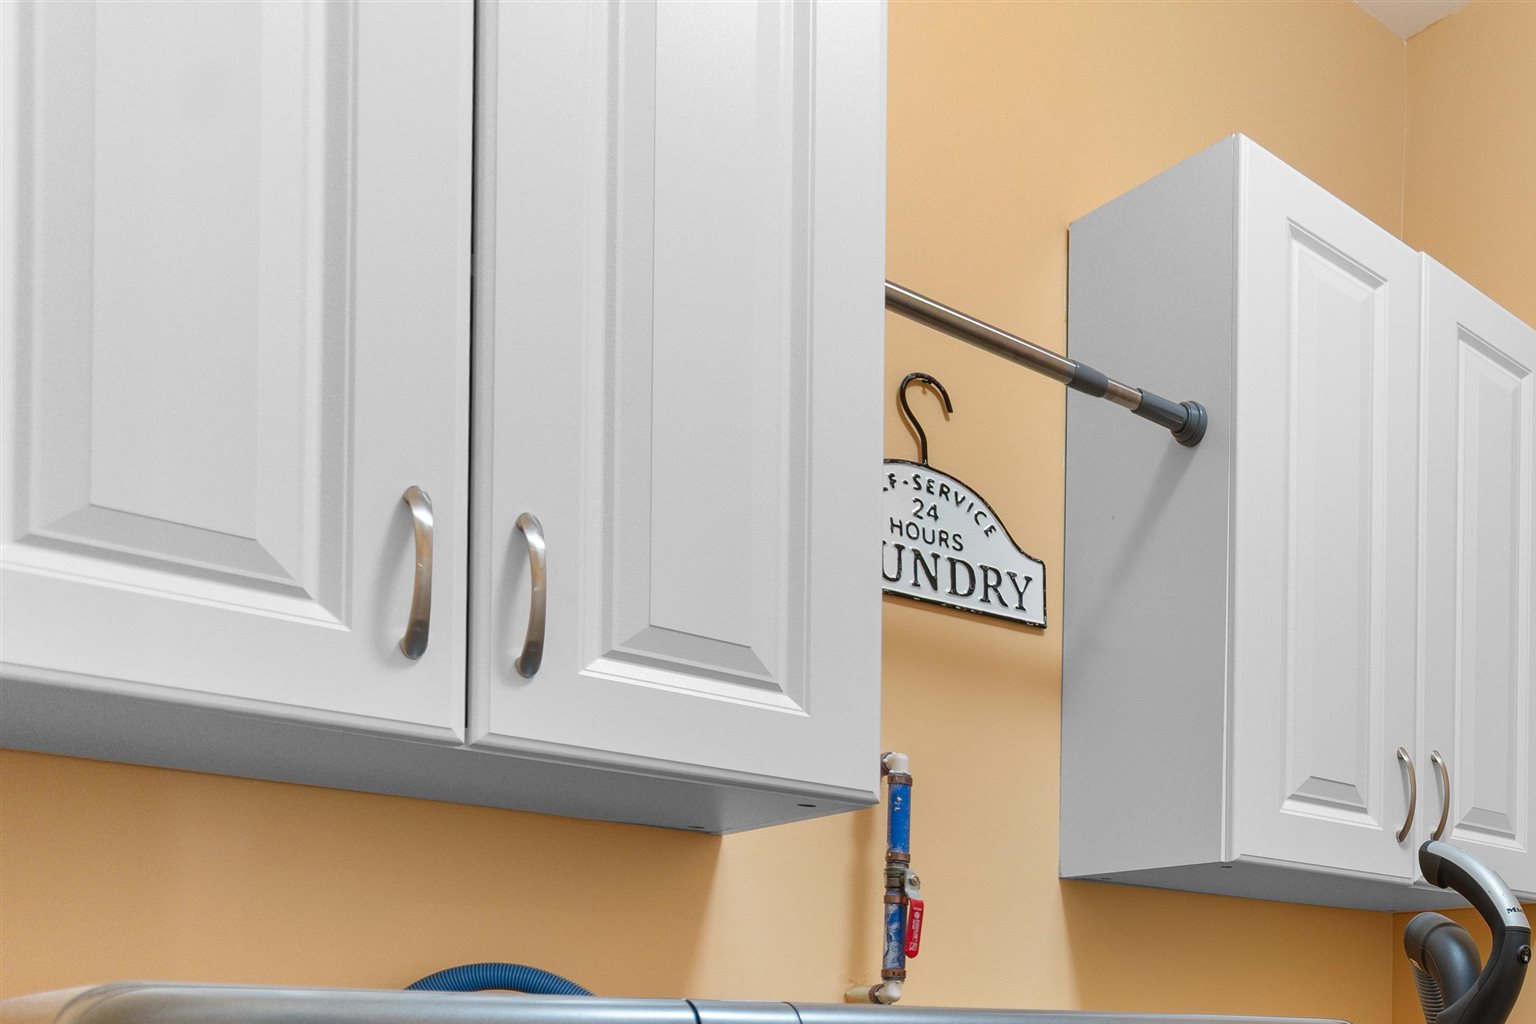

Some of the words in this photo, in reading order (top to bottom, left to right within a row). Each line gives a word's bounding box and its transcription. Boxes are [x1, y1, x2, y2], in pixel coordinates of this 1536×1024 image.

[883, 472, 997, 538] F-SERVICE
[911, 498, 940, 522] 24
[889, 516, 964, 552] HOURS
